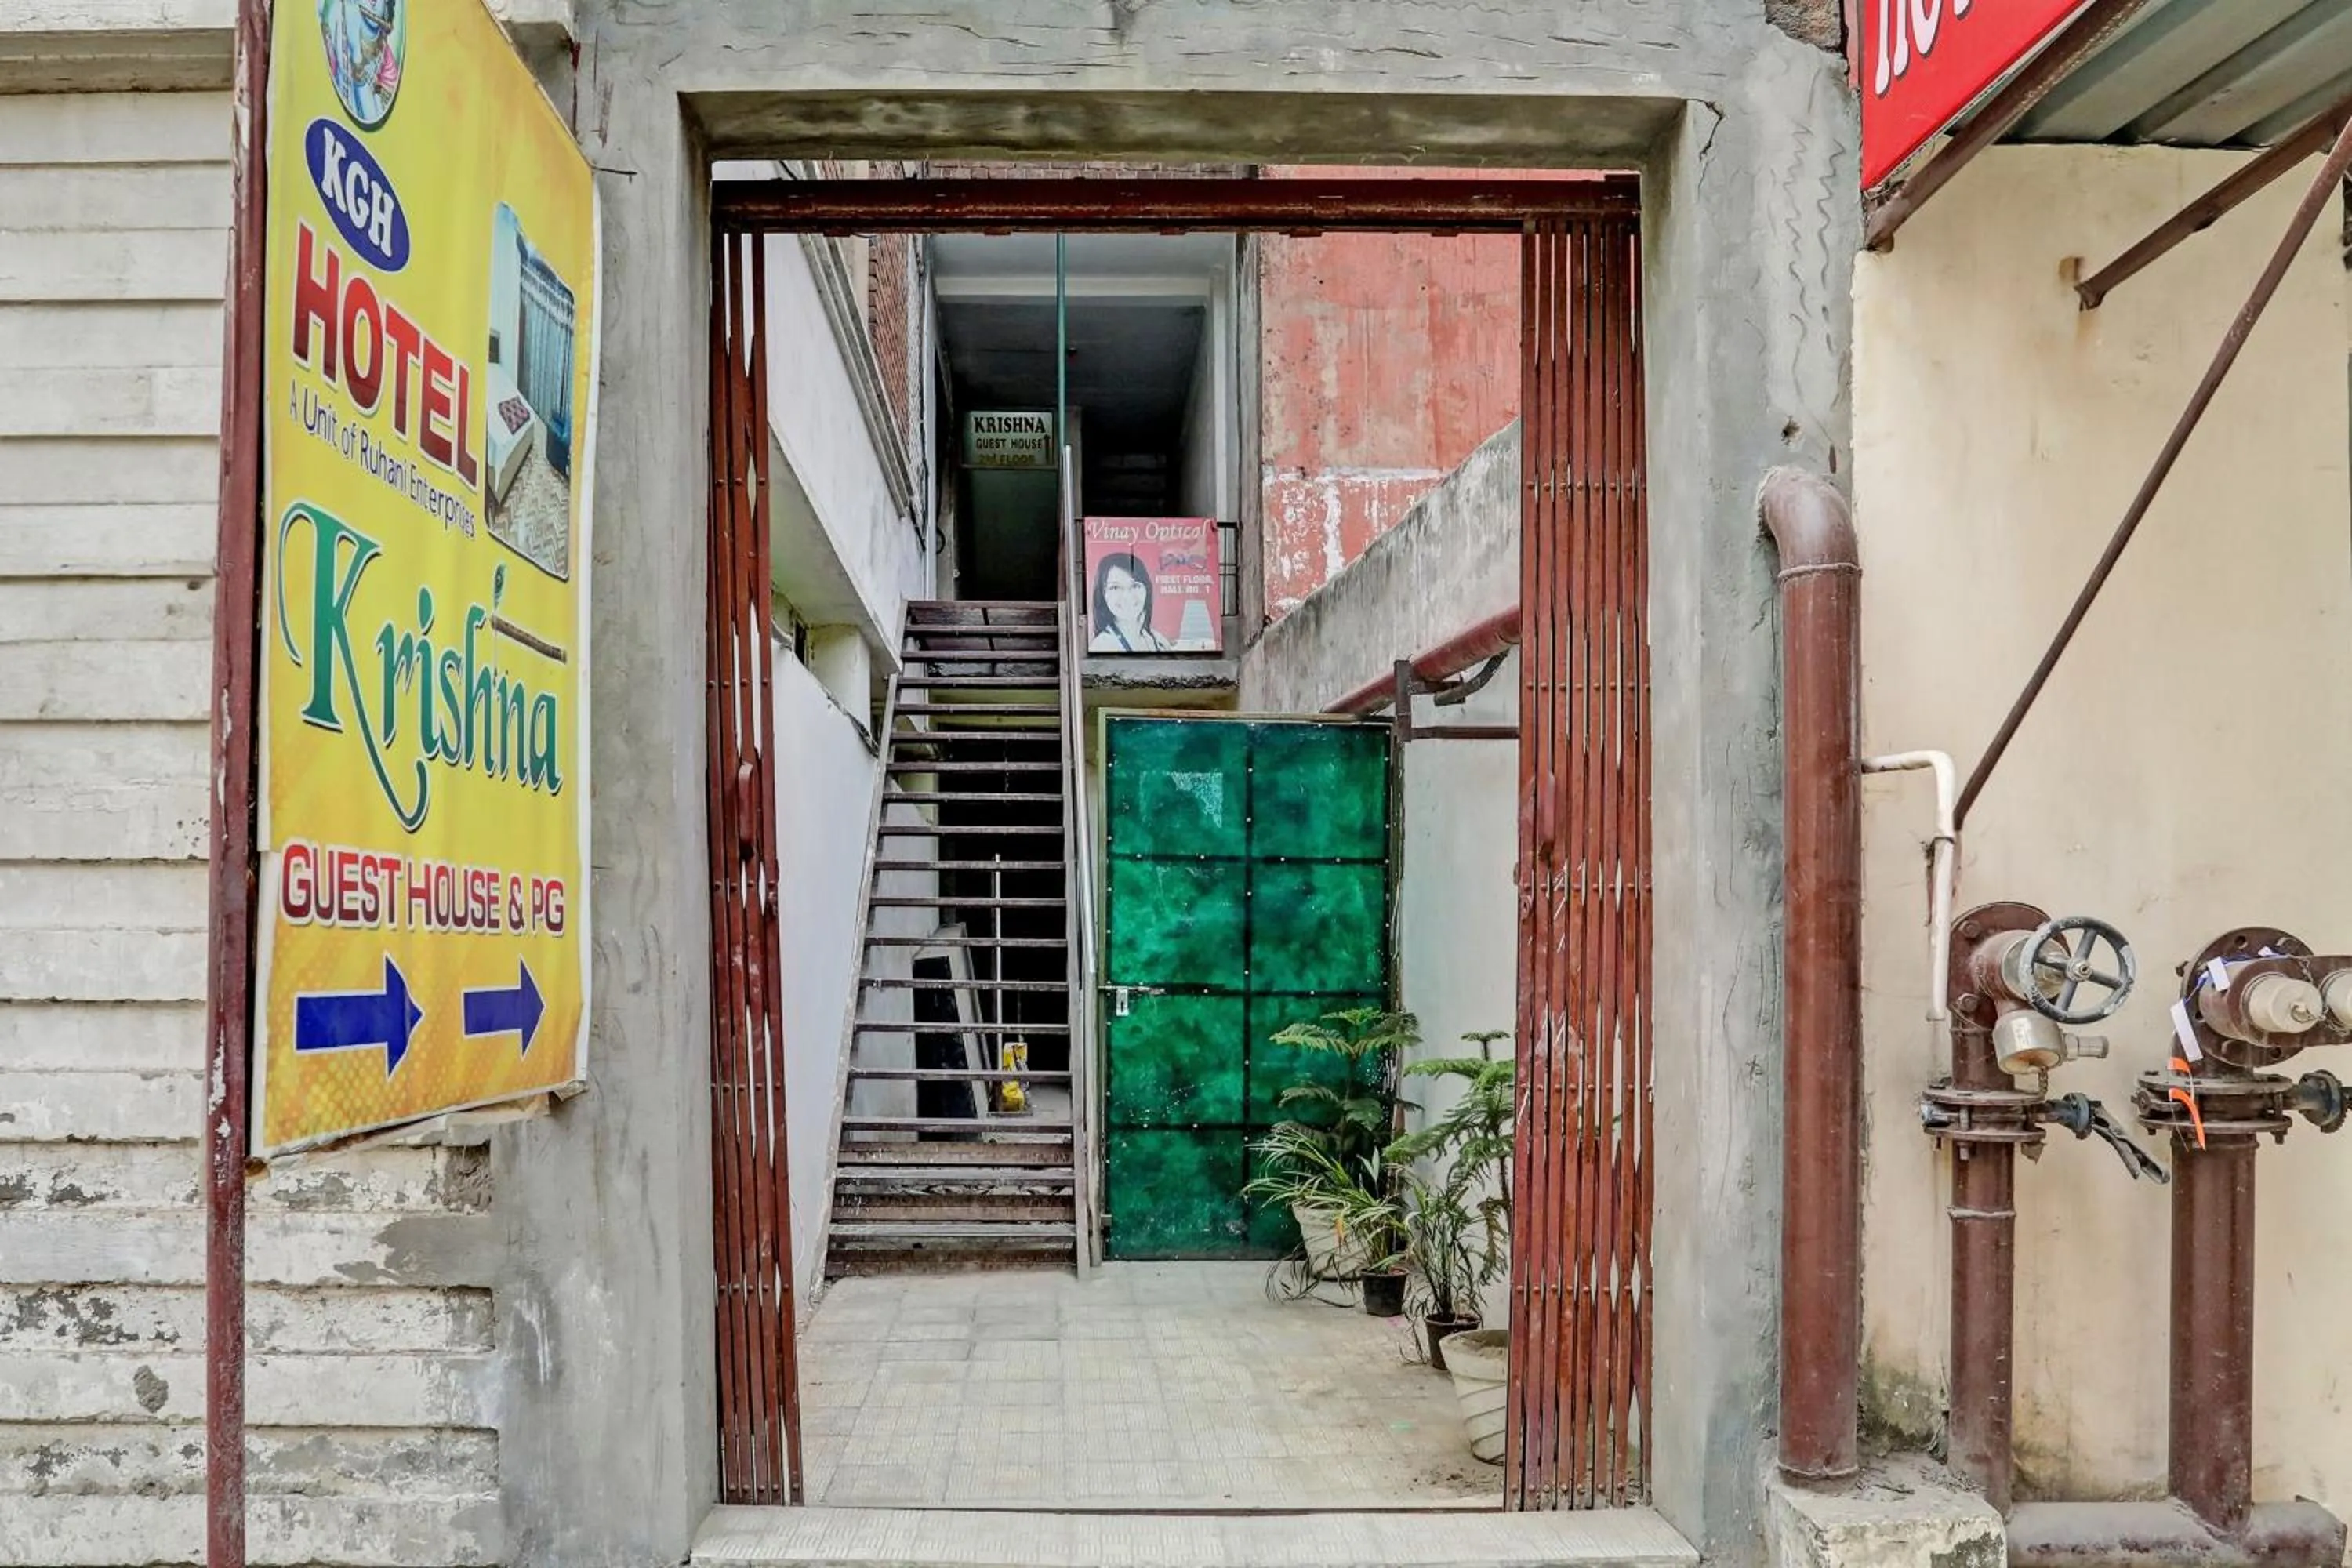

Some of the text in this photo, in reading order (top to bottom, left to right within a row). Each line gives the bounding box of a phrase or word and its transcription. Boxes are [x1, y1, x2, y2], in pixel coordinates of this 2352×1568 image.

[320, 127, 394, 258] KGH
[292, 222, 478, 489] HOTEL
[290, 379, 297, 422] A
[303, 387, 337, 448] Unit
[342, 423, 356, 458] of
[361, 429, 407, 497] Ruhani
[974, 416, 1046, 433] KRISHNA
[976, 438, 1042, 449] GUEST HOUSE
[1088, 519, 1211, 546] Vinay Optical
[278, 502, 562, 831] Krishna
[281, 843, 564, 932] GUEST HOUSE & PG
